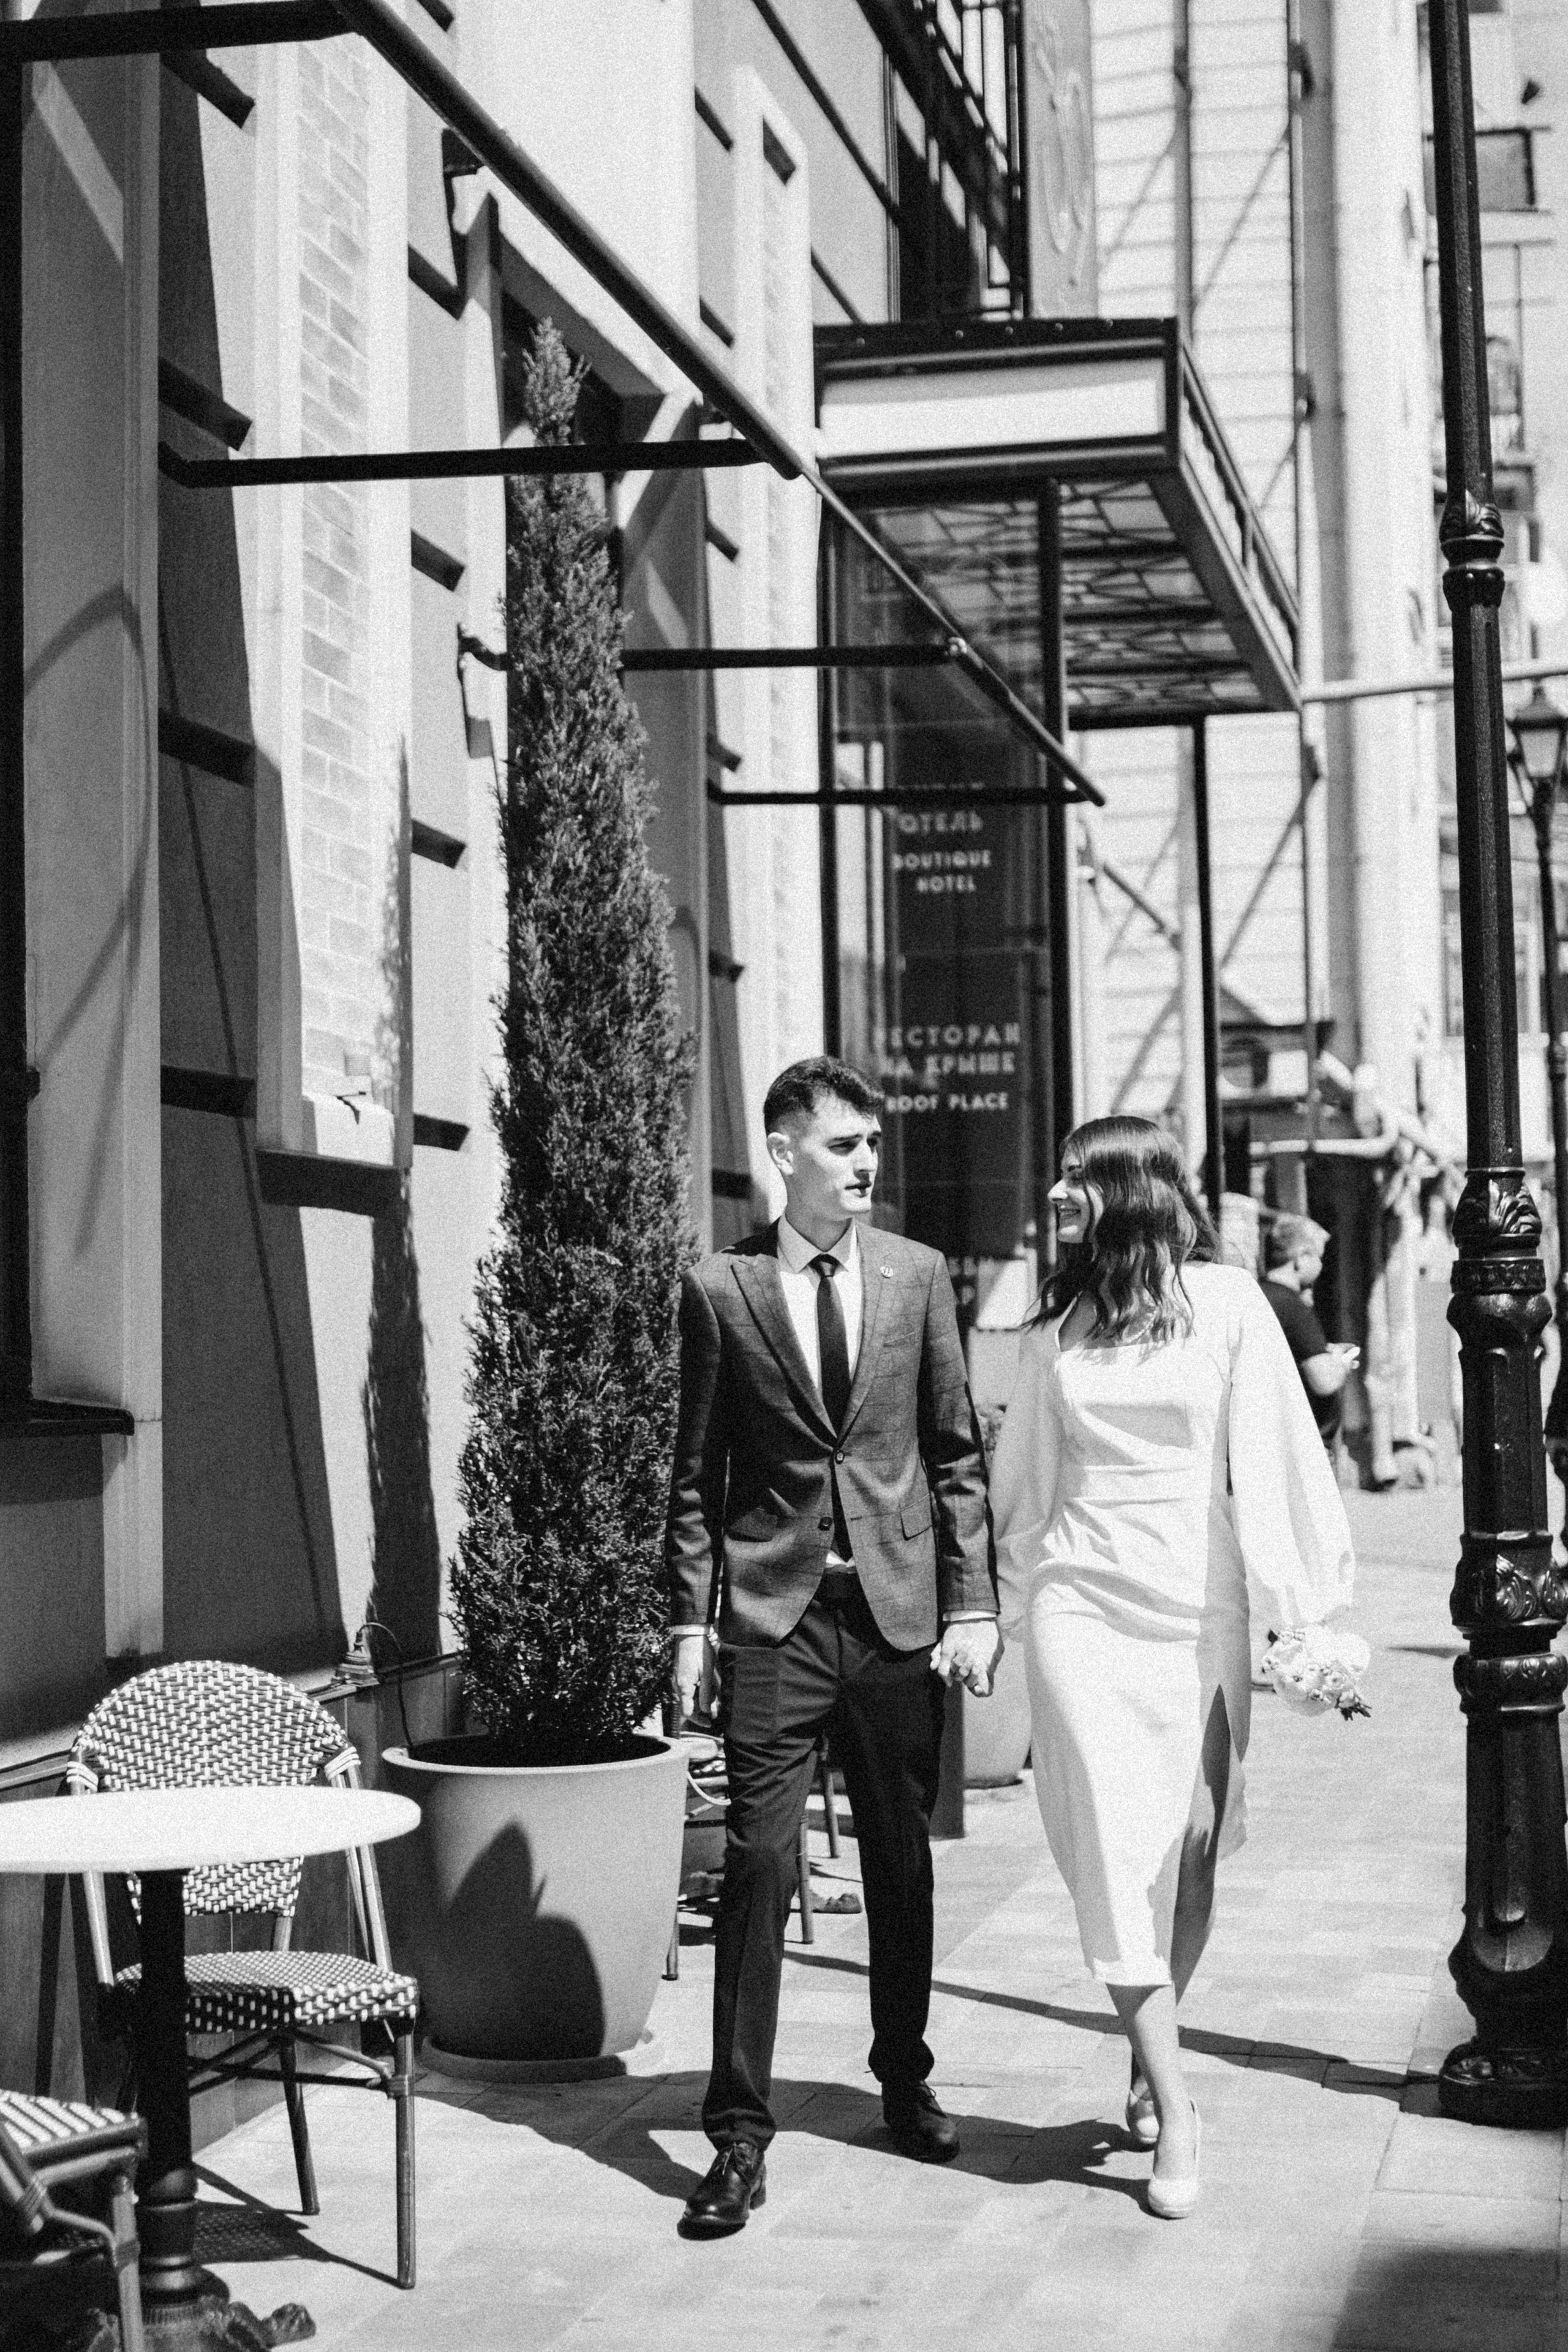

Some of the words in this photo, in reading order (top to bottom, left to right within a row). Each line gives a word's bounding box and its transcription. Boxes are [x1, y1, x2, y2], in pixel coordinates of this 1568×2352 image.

[899, 811, 983, 833] ОТЕЛЬ
[891, 850, 990, 870] BOUTIQUE
[917, 875, 976, 892] HOTEL
[949, 1091, 1008, 1110] PLACE
